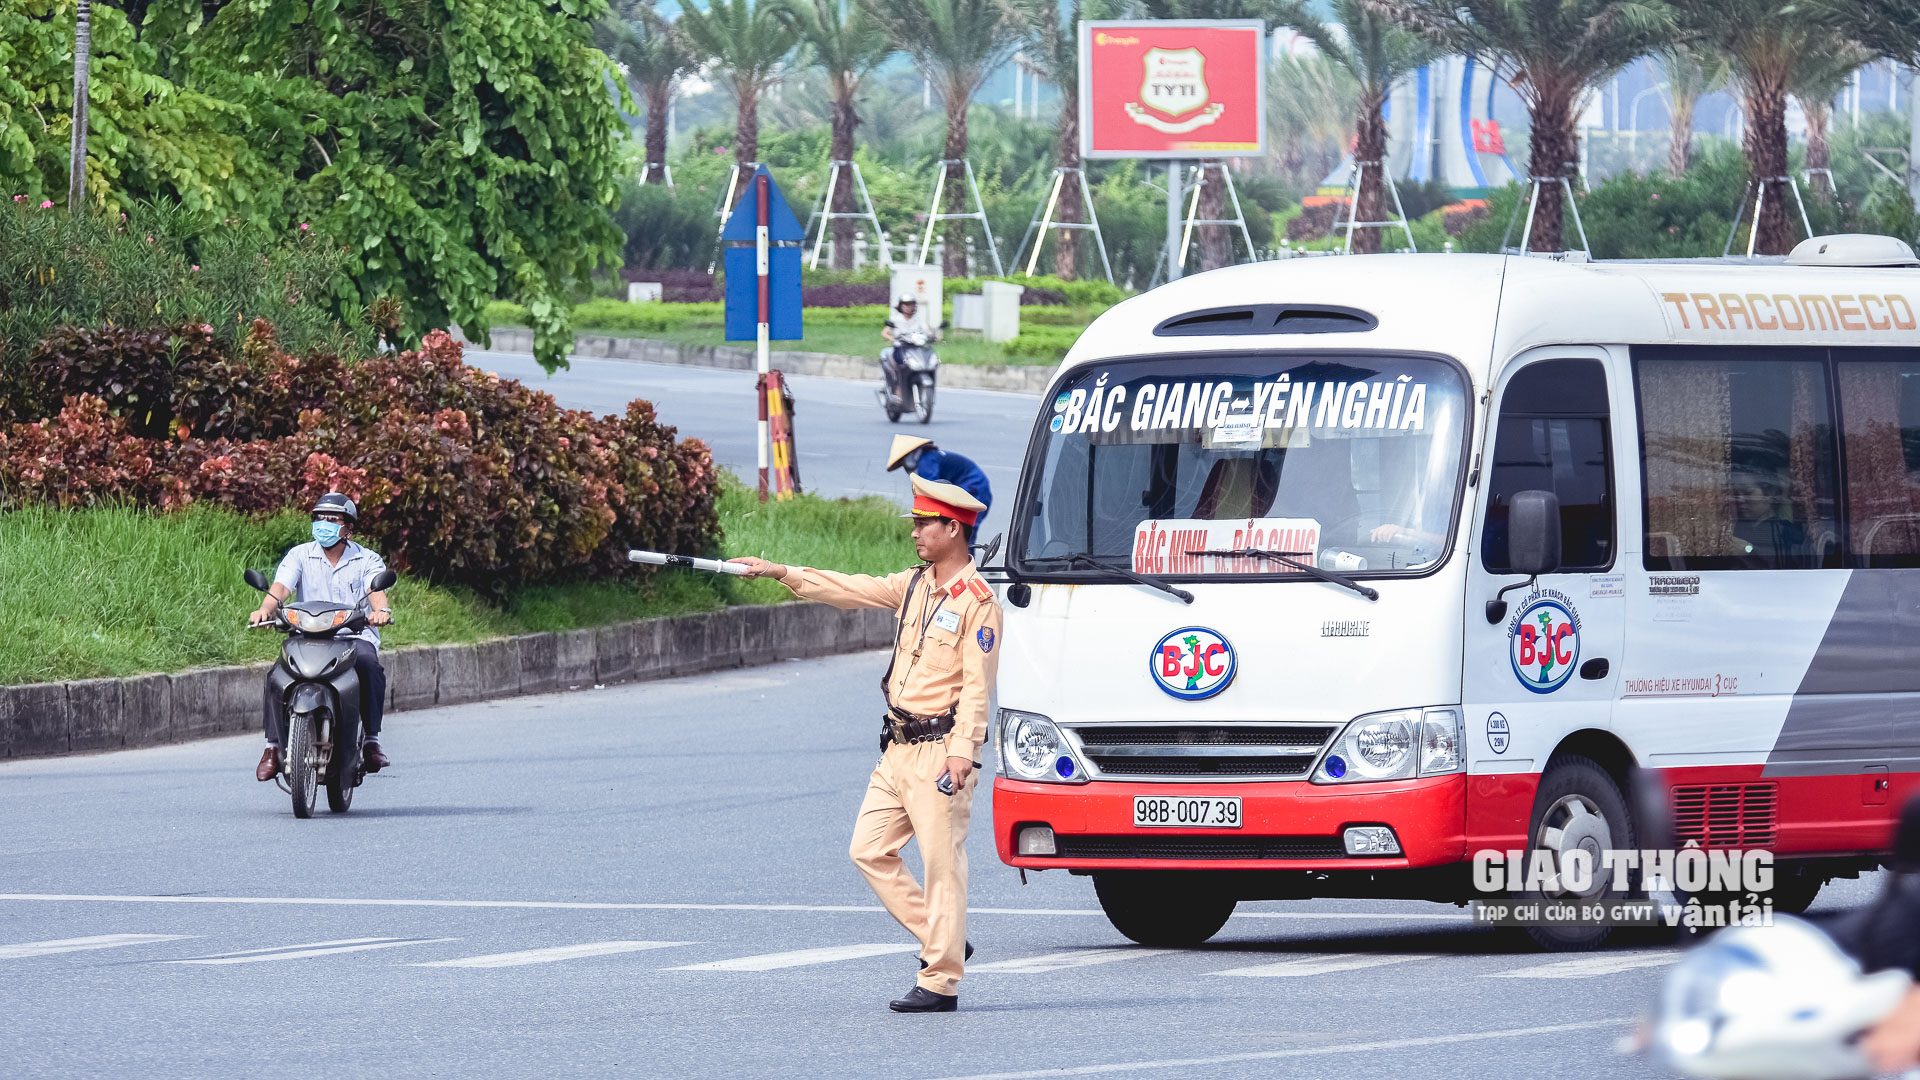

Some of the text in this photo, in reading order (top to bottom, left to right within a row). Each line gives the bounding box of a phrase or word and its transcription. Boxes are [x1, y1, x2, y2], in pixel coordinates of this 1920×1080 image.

[1152, 84, 1196, 96] TYTI
[1661, 292, 1917, 330] TRACOMECO
[1061, 372, 1427, 434] BẮC GIANG YÊN NGHĨA
[1135, 520, 1166, 575] BẮC
[1168, 529, 1208, 575] NINH
[1232, 519, 1264, 574] BẮC
[1266, 528, 1316, 573] GIANG
[1541, 589, 1548, 598] XE
[1548, 588, 1564, 601] KHÁCH
[1162, 643, 1225, 677] BJC
[1520, 622, 1573, 667] BJC
[1654, 676, 1670, 693] HIỆU
[1671, 678, 1680, 691] XE
[1681, 677, 1712, 691] HYUNDAI
[1711, 673, 1722, 698] 3
[1723, 677, 1738, 692] CỤC
[1136, 799, 1238, 824] 98B-007.39
